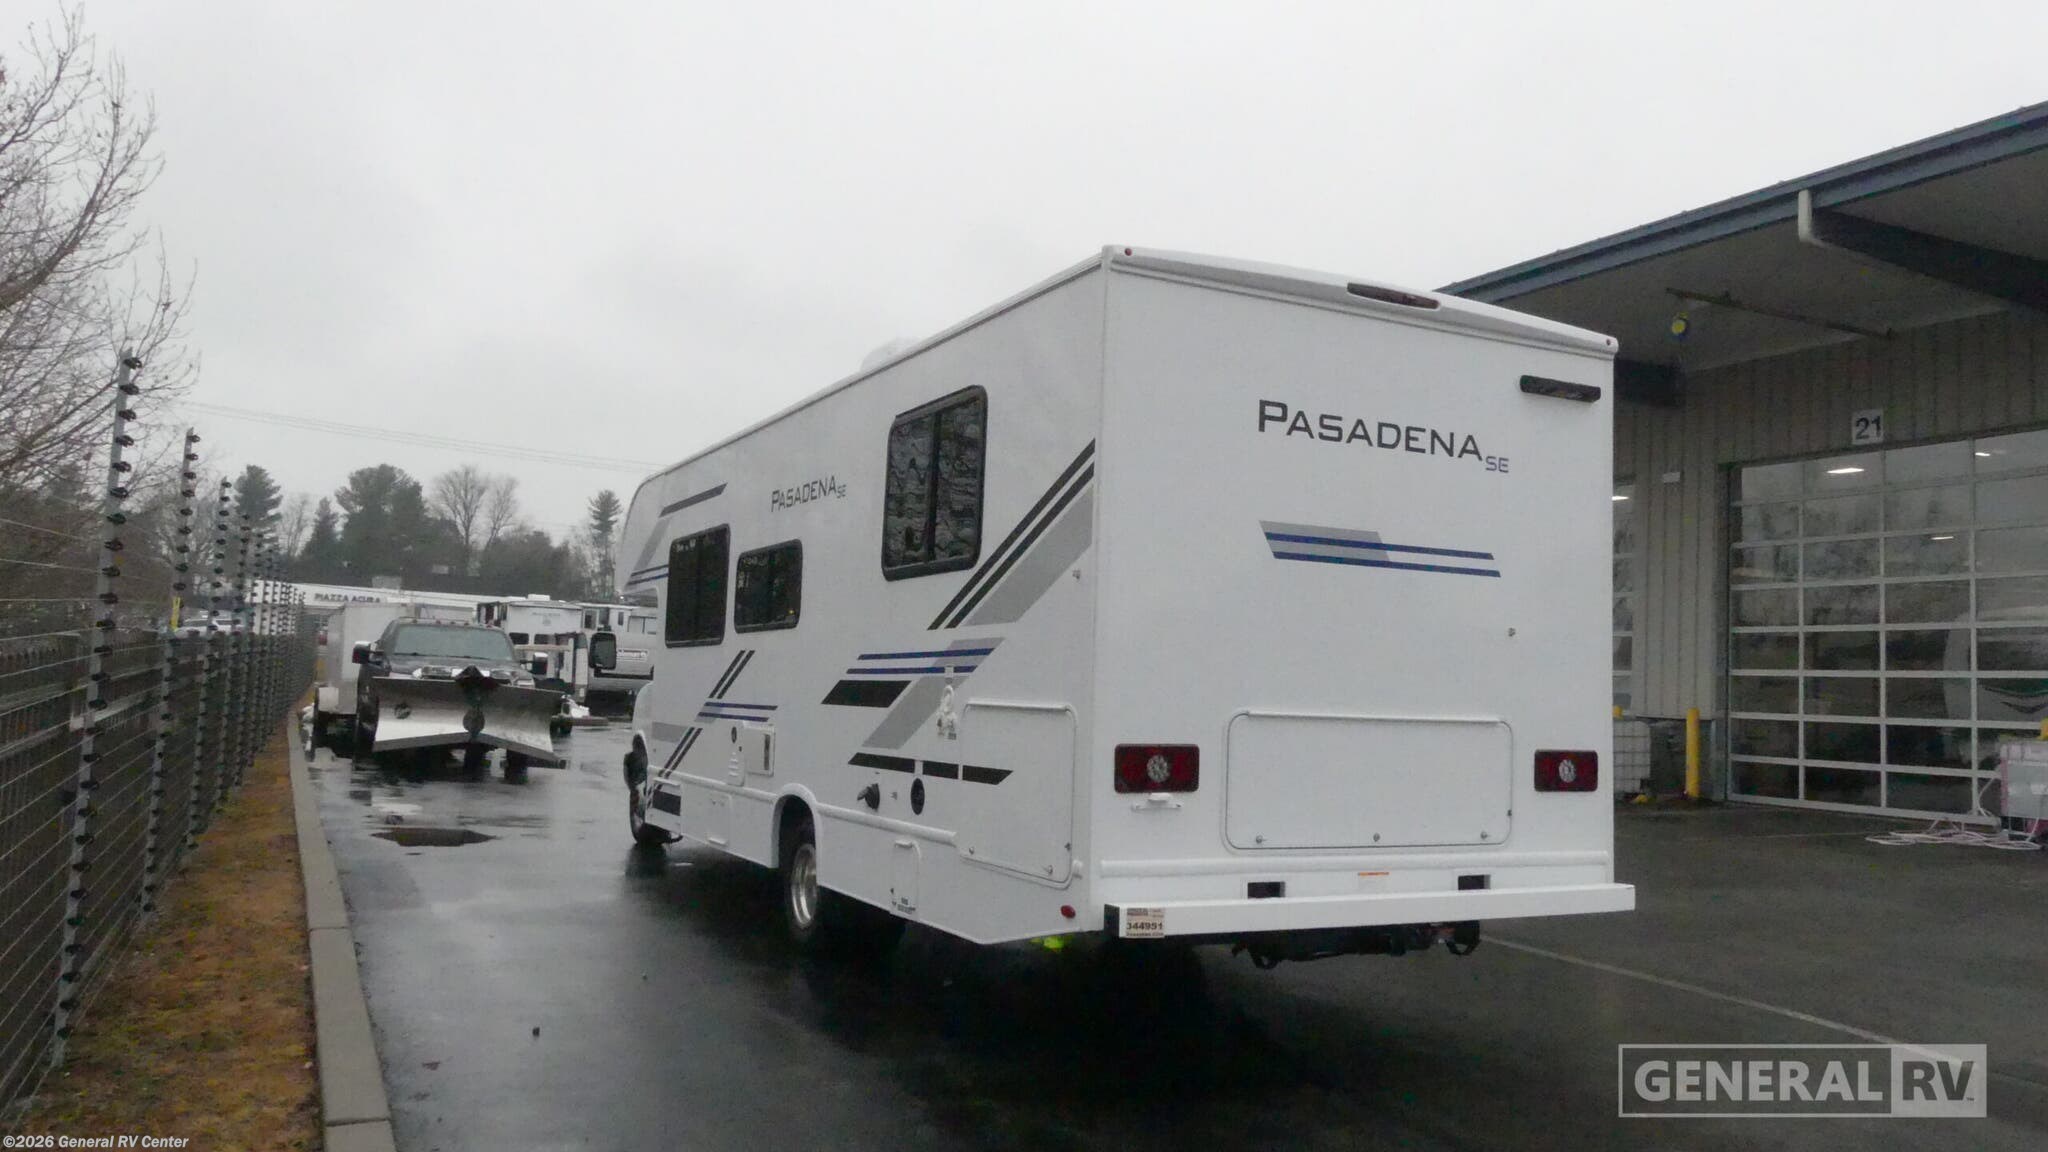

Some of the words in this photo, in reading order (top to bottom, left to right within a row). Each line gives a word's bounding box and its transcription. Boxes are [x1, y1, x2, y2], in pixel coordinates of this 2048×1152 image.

[1258, 399, 1483, 461] PASADENA
[1485, 456, 1509, 473] SE
[1855, 416, 1881, 440] 21
[771, 475, 836, 512] PASADENA
[314, 592, 349, 602] PIAZZA
[351, 595, 380, 603] ACURA
